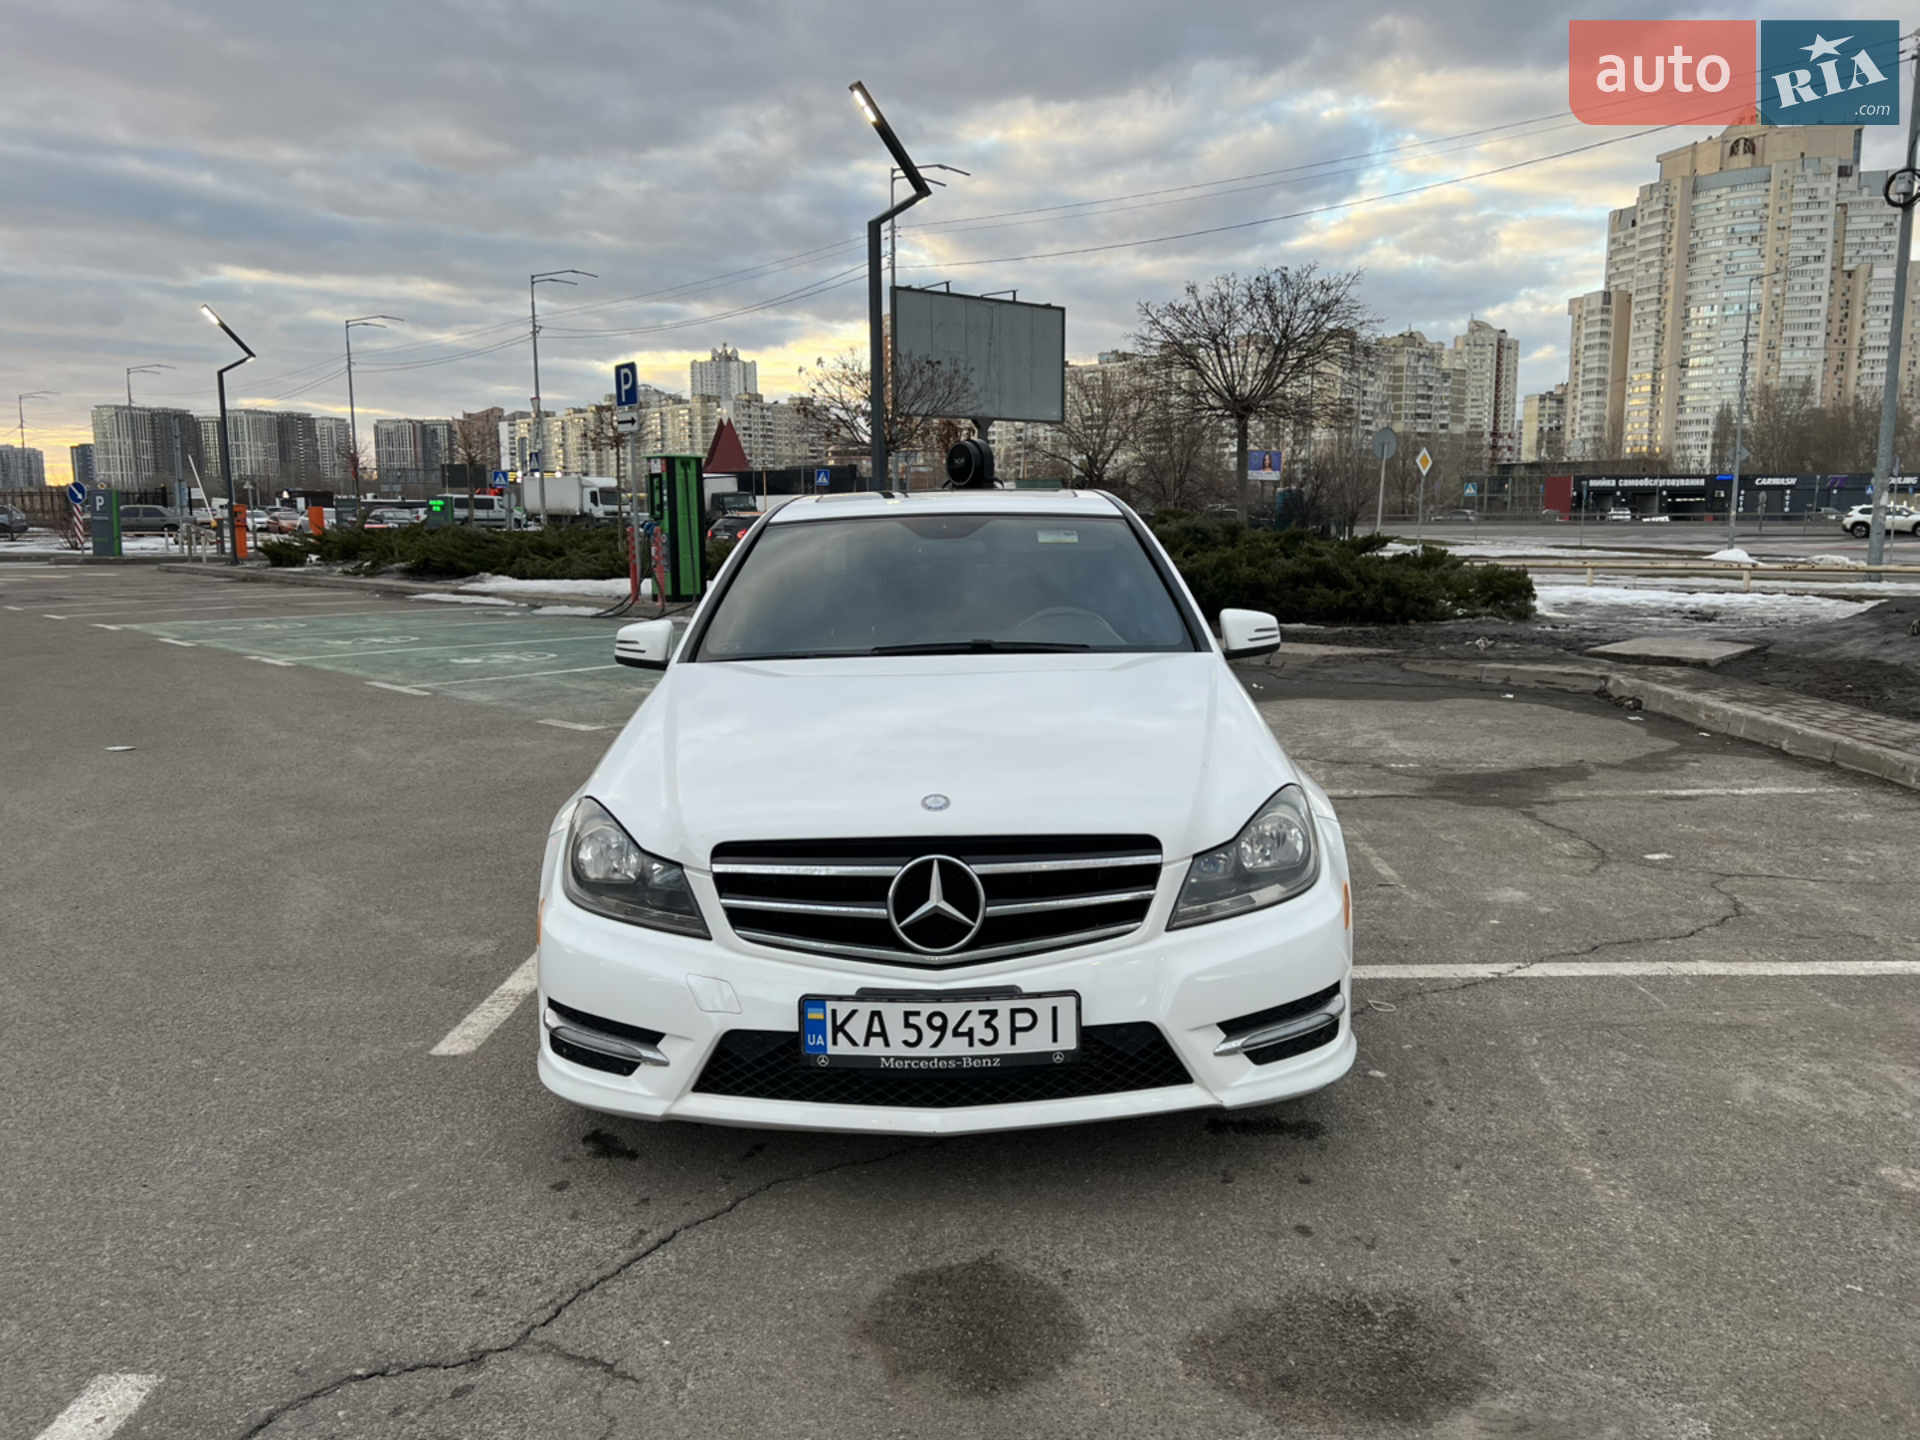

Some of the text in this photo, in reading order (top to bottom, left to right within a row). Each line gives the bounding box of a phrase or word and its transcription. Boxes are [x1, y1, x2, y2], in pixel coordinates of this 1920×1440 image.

[620, 368, 633, 402] P
[1755, 477, 1797, 485] CARWASH
[95, 495, 104, 511] P
[807, 1035, 825, 1046] UA
[880, 1057, 1001, 1069] Mercedes-Benz
